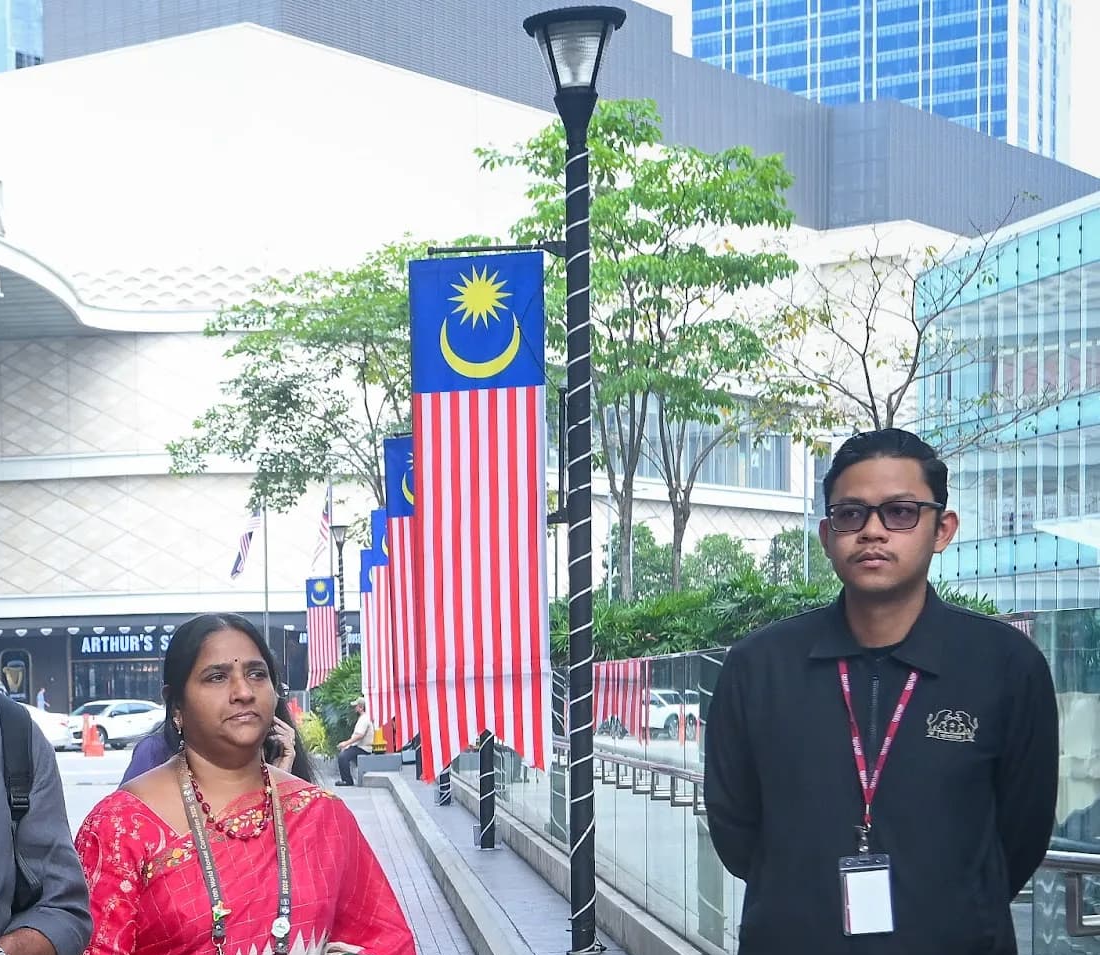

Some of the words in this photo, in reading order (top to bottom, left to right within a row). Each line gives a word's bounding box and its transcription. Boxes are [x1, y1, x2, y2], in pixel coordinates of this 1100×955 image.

[81, 633, 154, 653] ARTHUR'S
[192, 818, 208, 850] Convention
[279, 846, 288, 879] Convention
[207, 870, 217, 888] World
[211, 888, 220, 901] 10th
